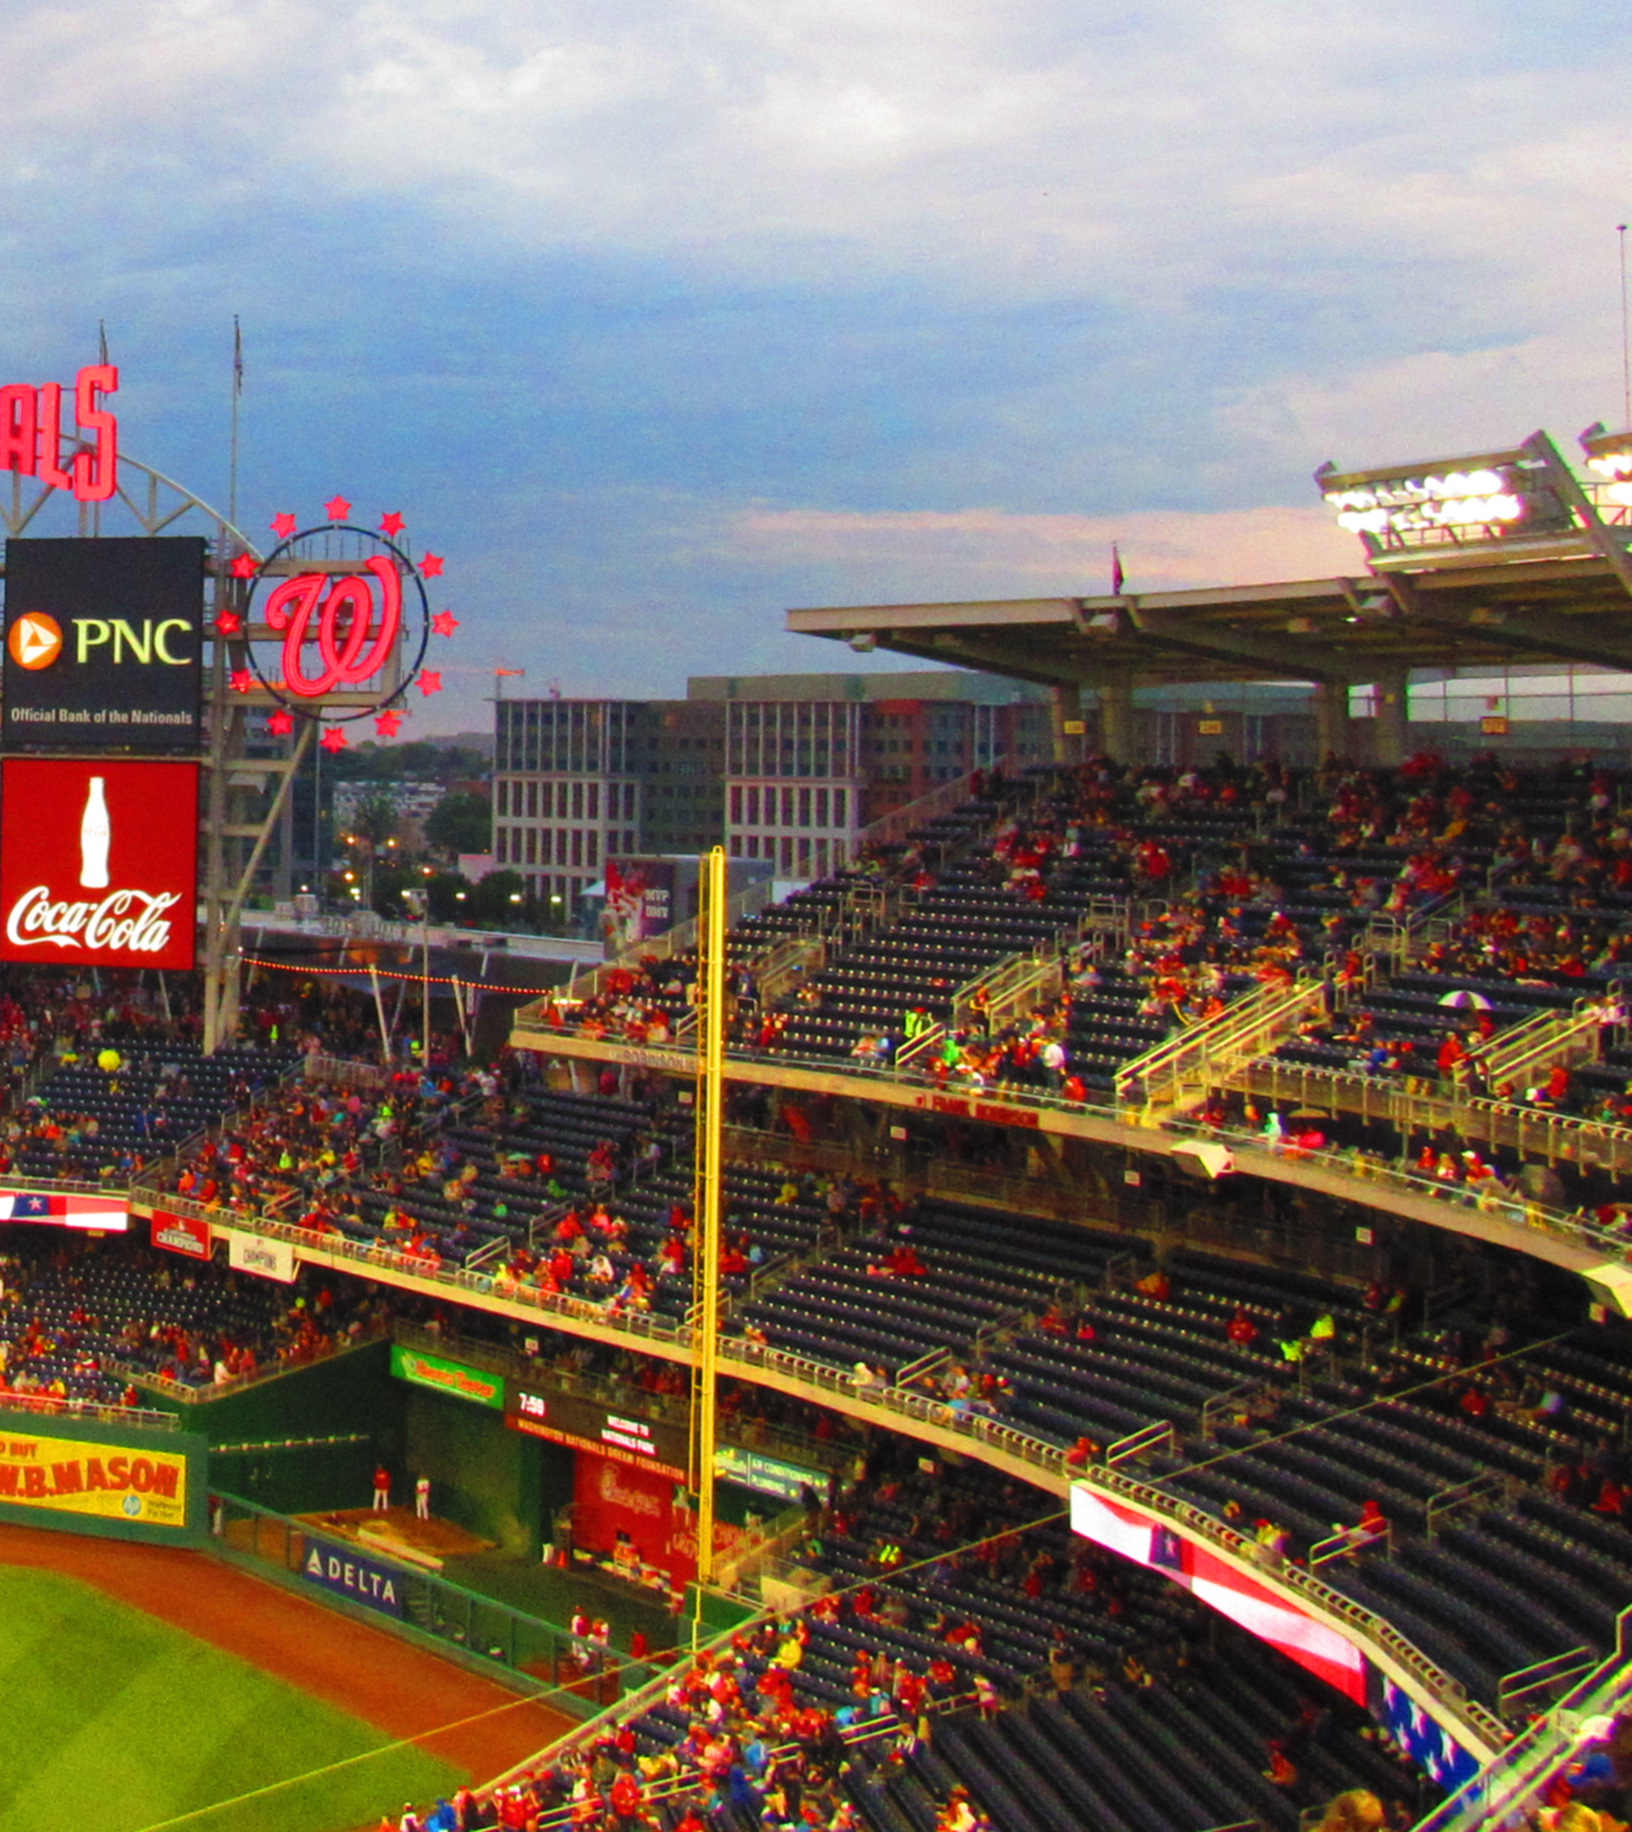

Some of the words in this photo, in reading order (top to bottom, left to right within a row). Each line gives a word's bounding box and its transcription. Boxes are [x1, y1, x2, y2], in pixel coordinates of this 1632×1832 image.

[71, 618, 194, 665] PNC
[11, 707, 55, 722] Official
[59, 708, 90, 723] Bank
[94, 709, 107, 723] of
[109, 711, 128, 724] the
[131, 710, 193, 725] Nationals
[6, 886, 183, 952] Coca-Cola
[10, 1442, 37, 1458] BUT
[328, 1556, 396, 1604] DELTA
